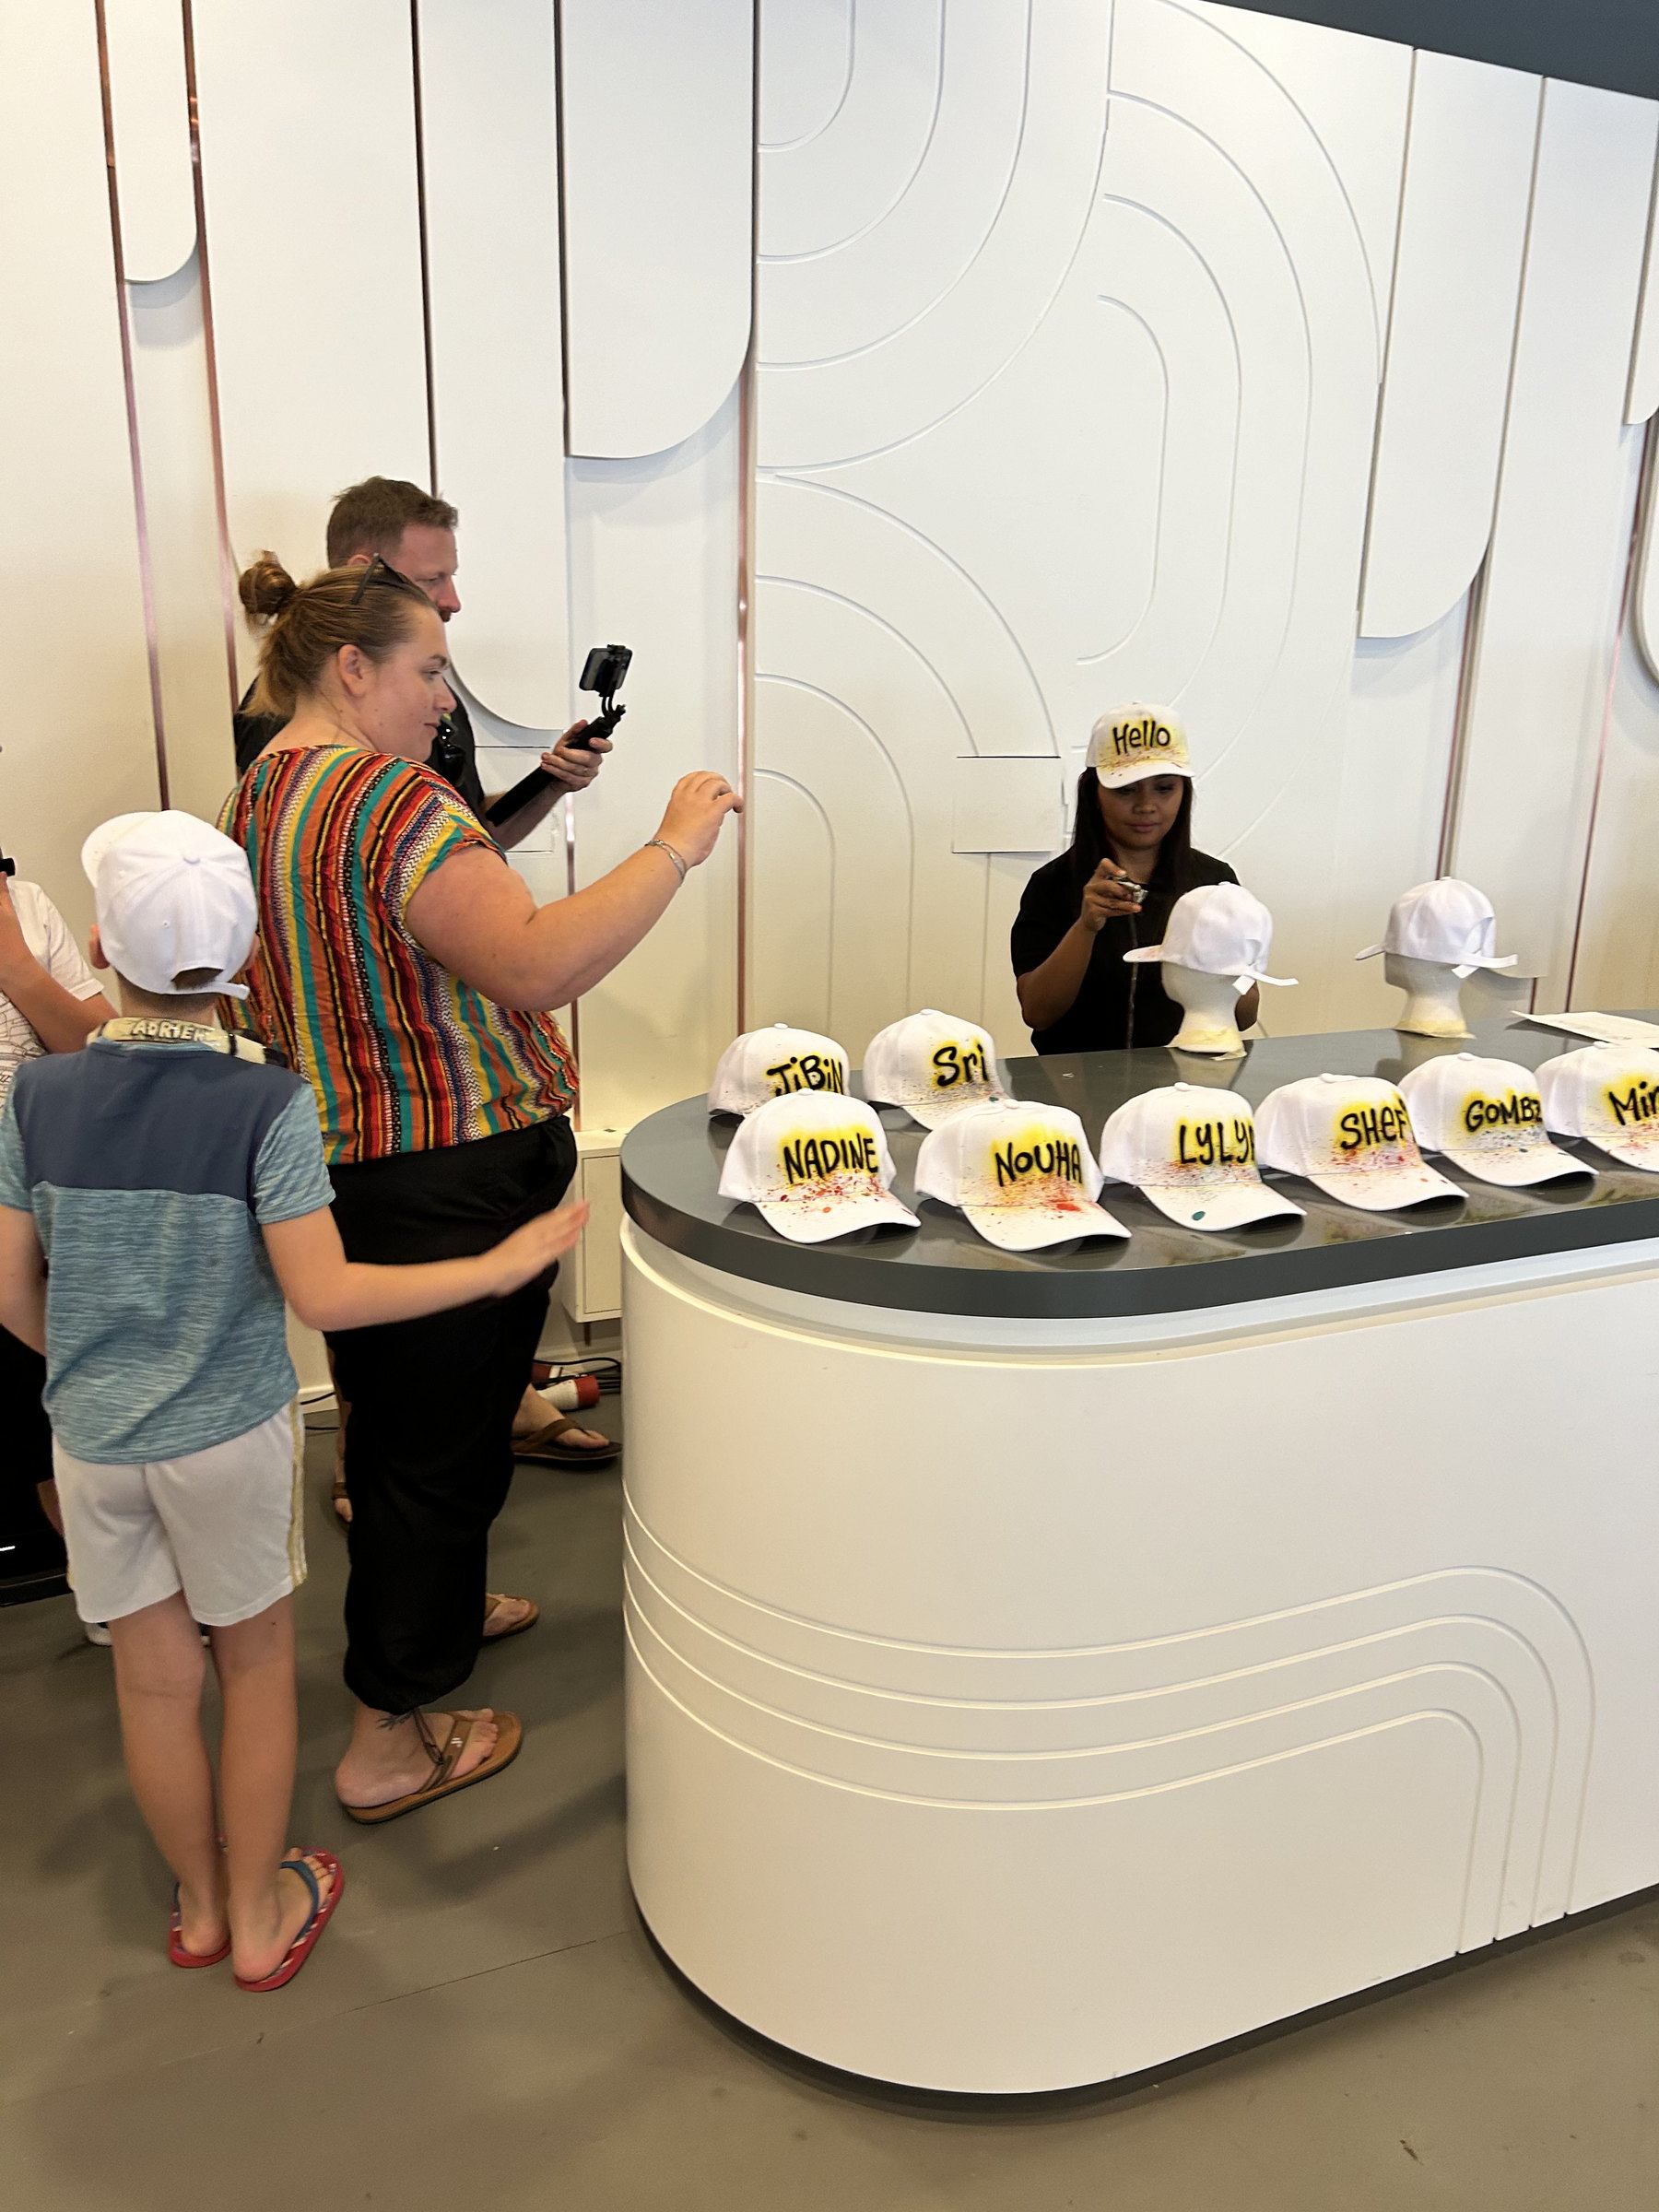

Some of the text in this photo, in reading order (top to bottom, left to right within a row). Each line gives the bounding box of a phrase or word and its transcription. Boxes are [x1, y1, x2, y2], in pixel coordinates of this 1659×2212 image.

[1112, 719, 1171, 756] Hello
[933, 1043, 990, 1087] Sri
[783, 1132, 878, 1185] NADINE
